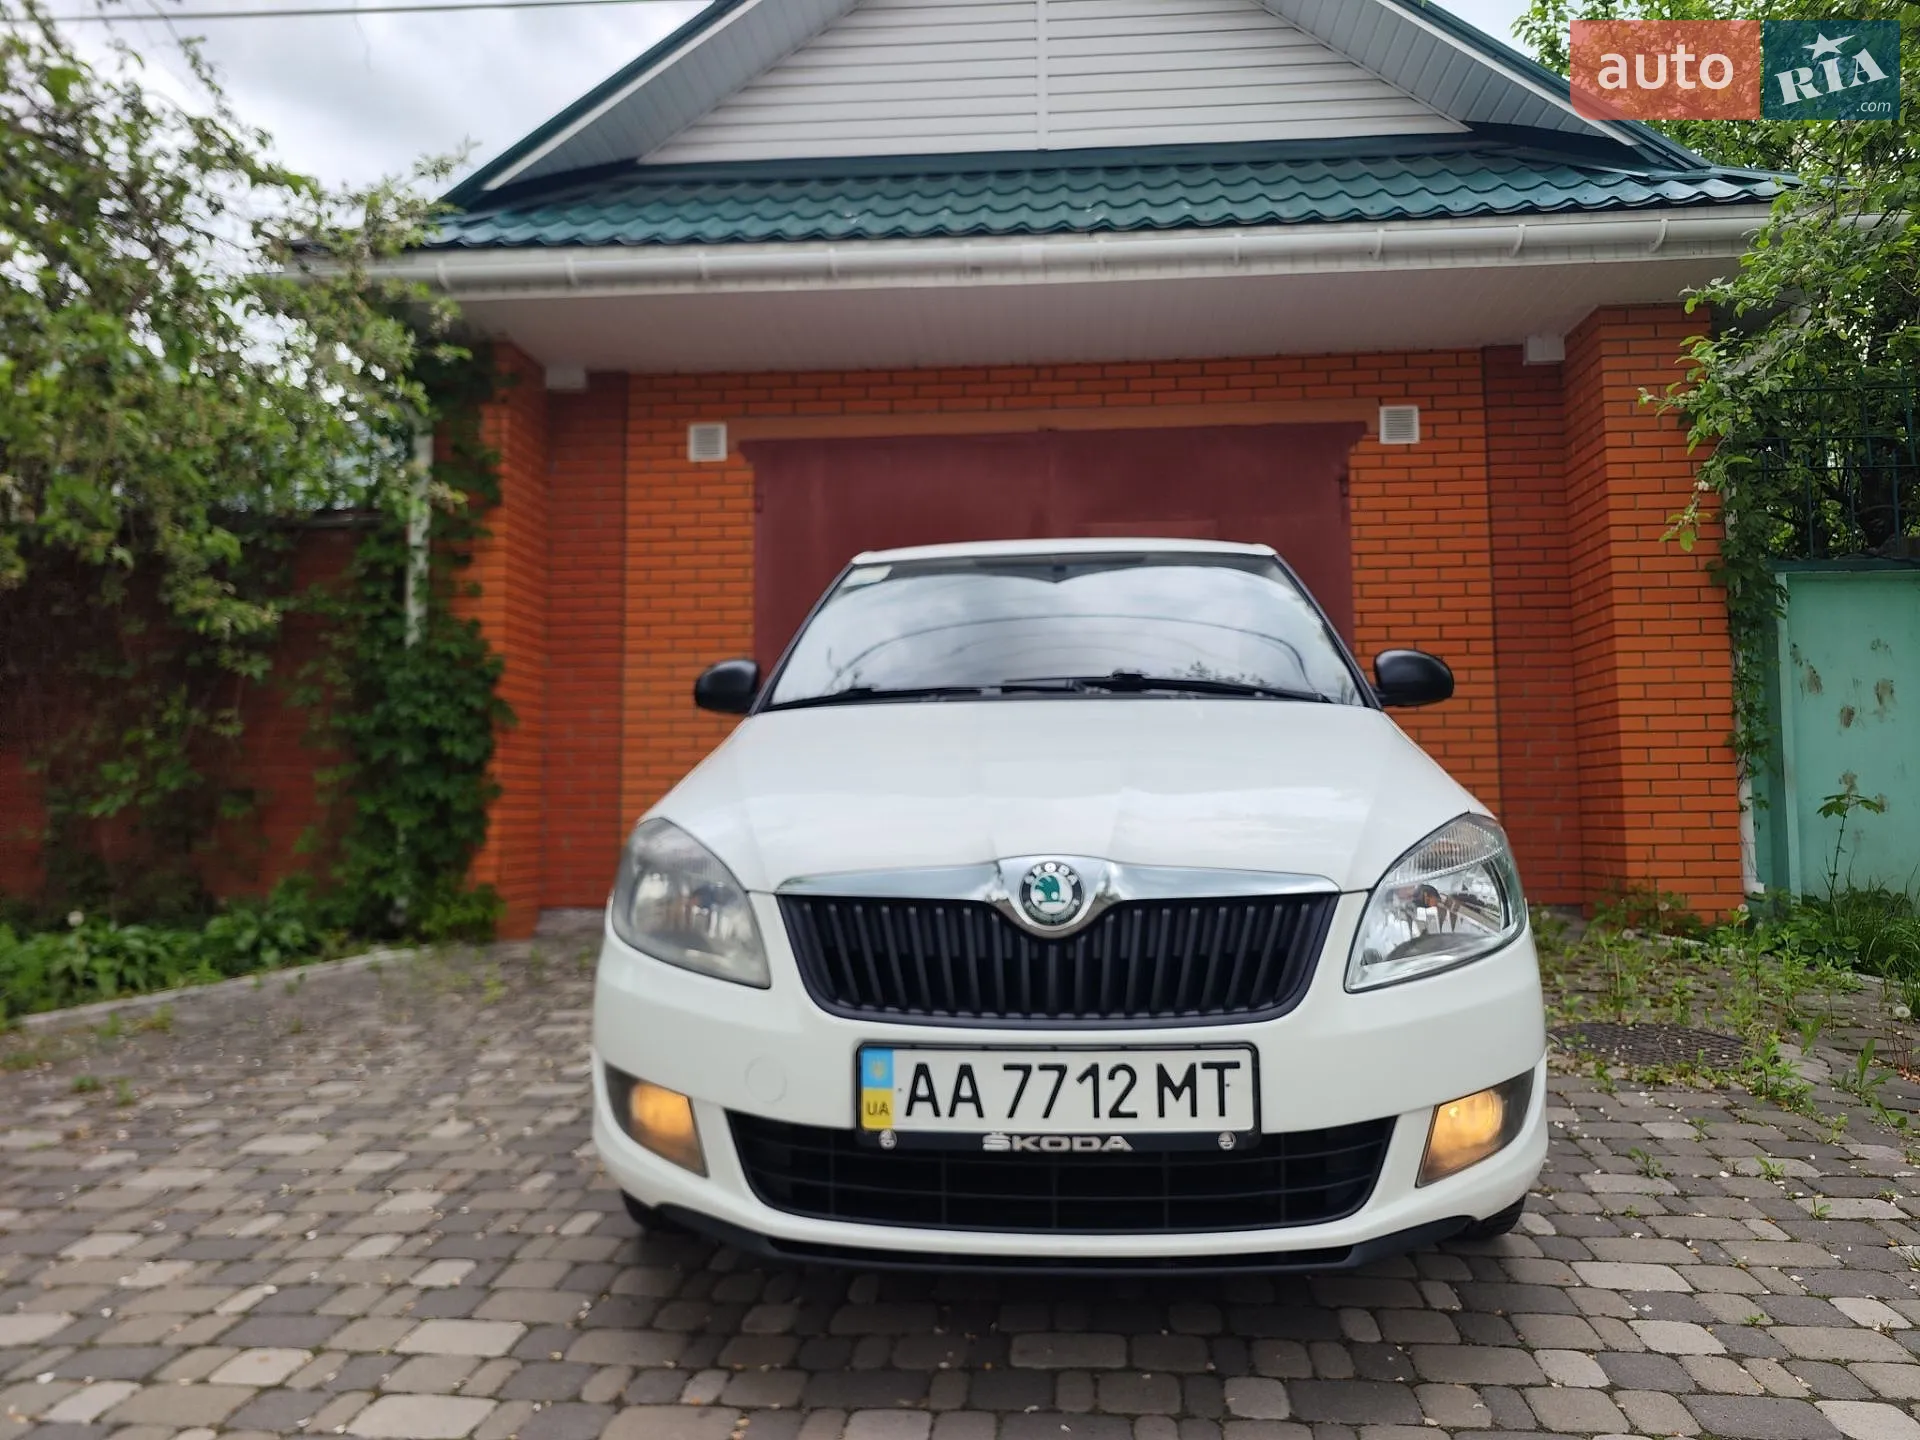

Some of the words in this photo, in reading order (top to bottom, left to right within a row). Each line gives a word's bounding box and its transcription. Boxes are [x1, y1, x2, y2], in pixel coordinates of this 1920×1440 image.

[905, 1063, 984, 1117] AA
[1003, 1063, 1138, 1118] 7712
[1157, 1061, 1241, 1118] MT
[866, 1102, 890, 1115] UA
[983, 1132, 1133, 1151] ŠKODA
